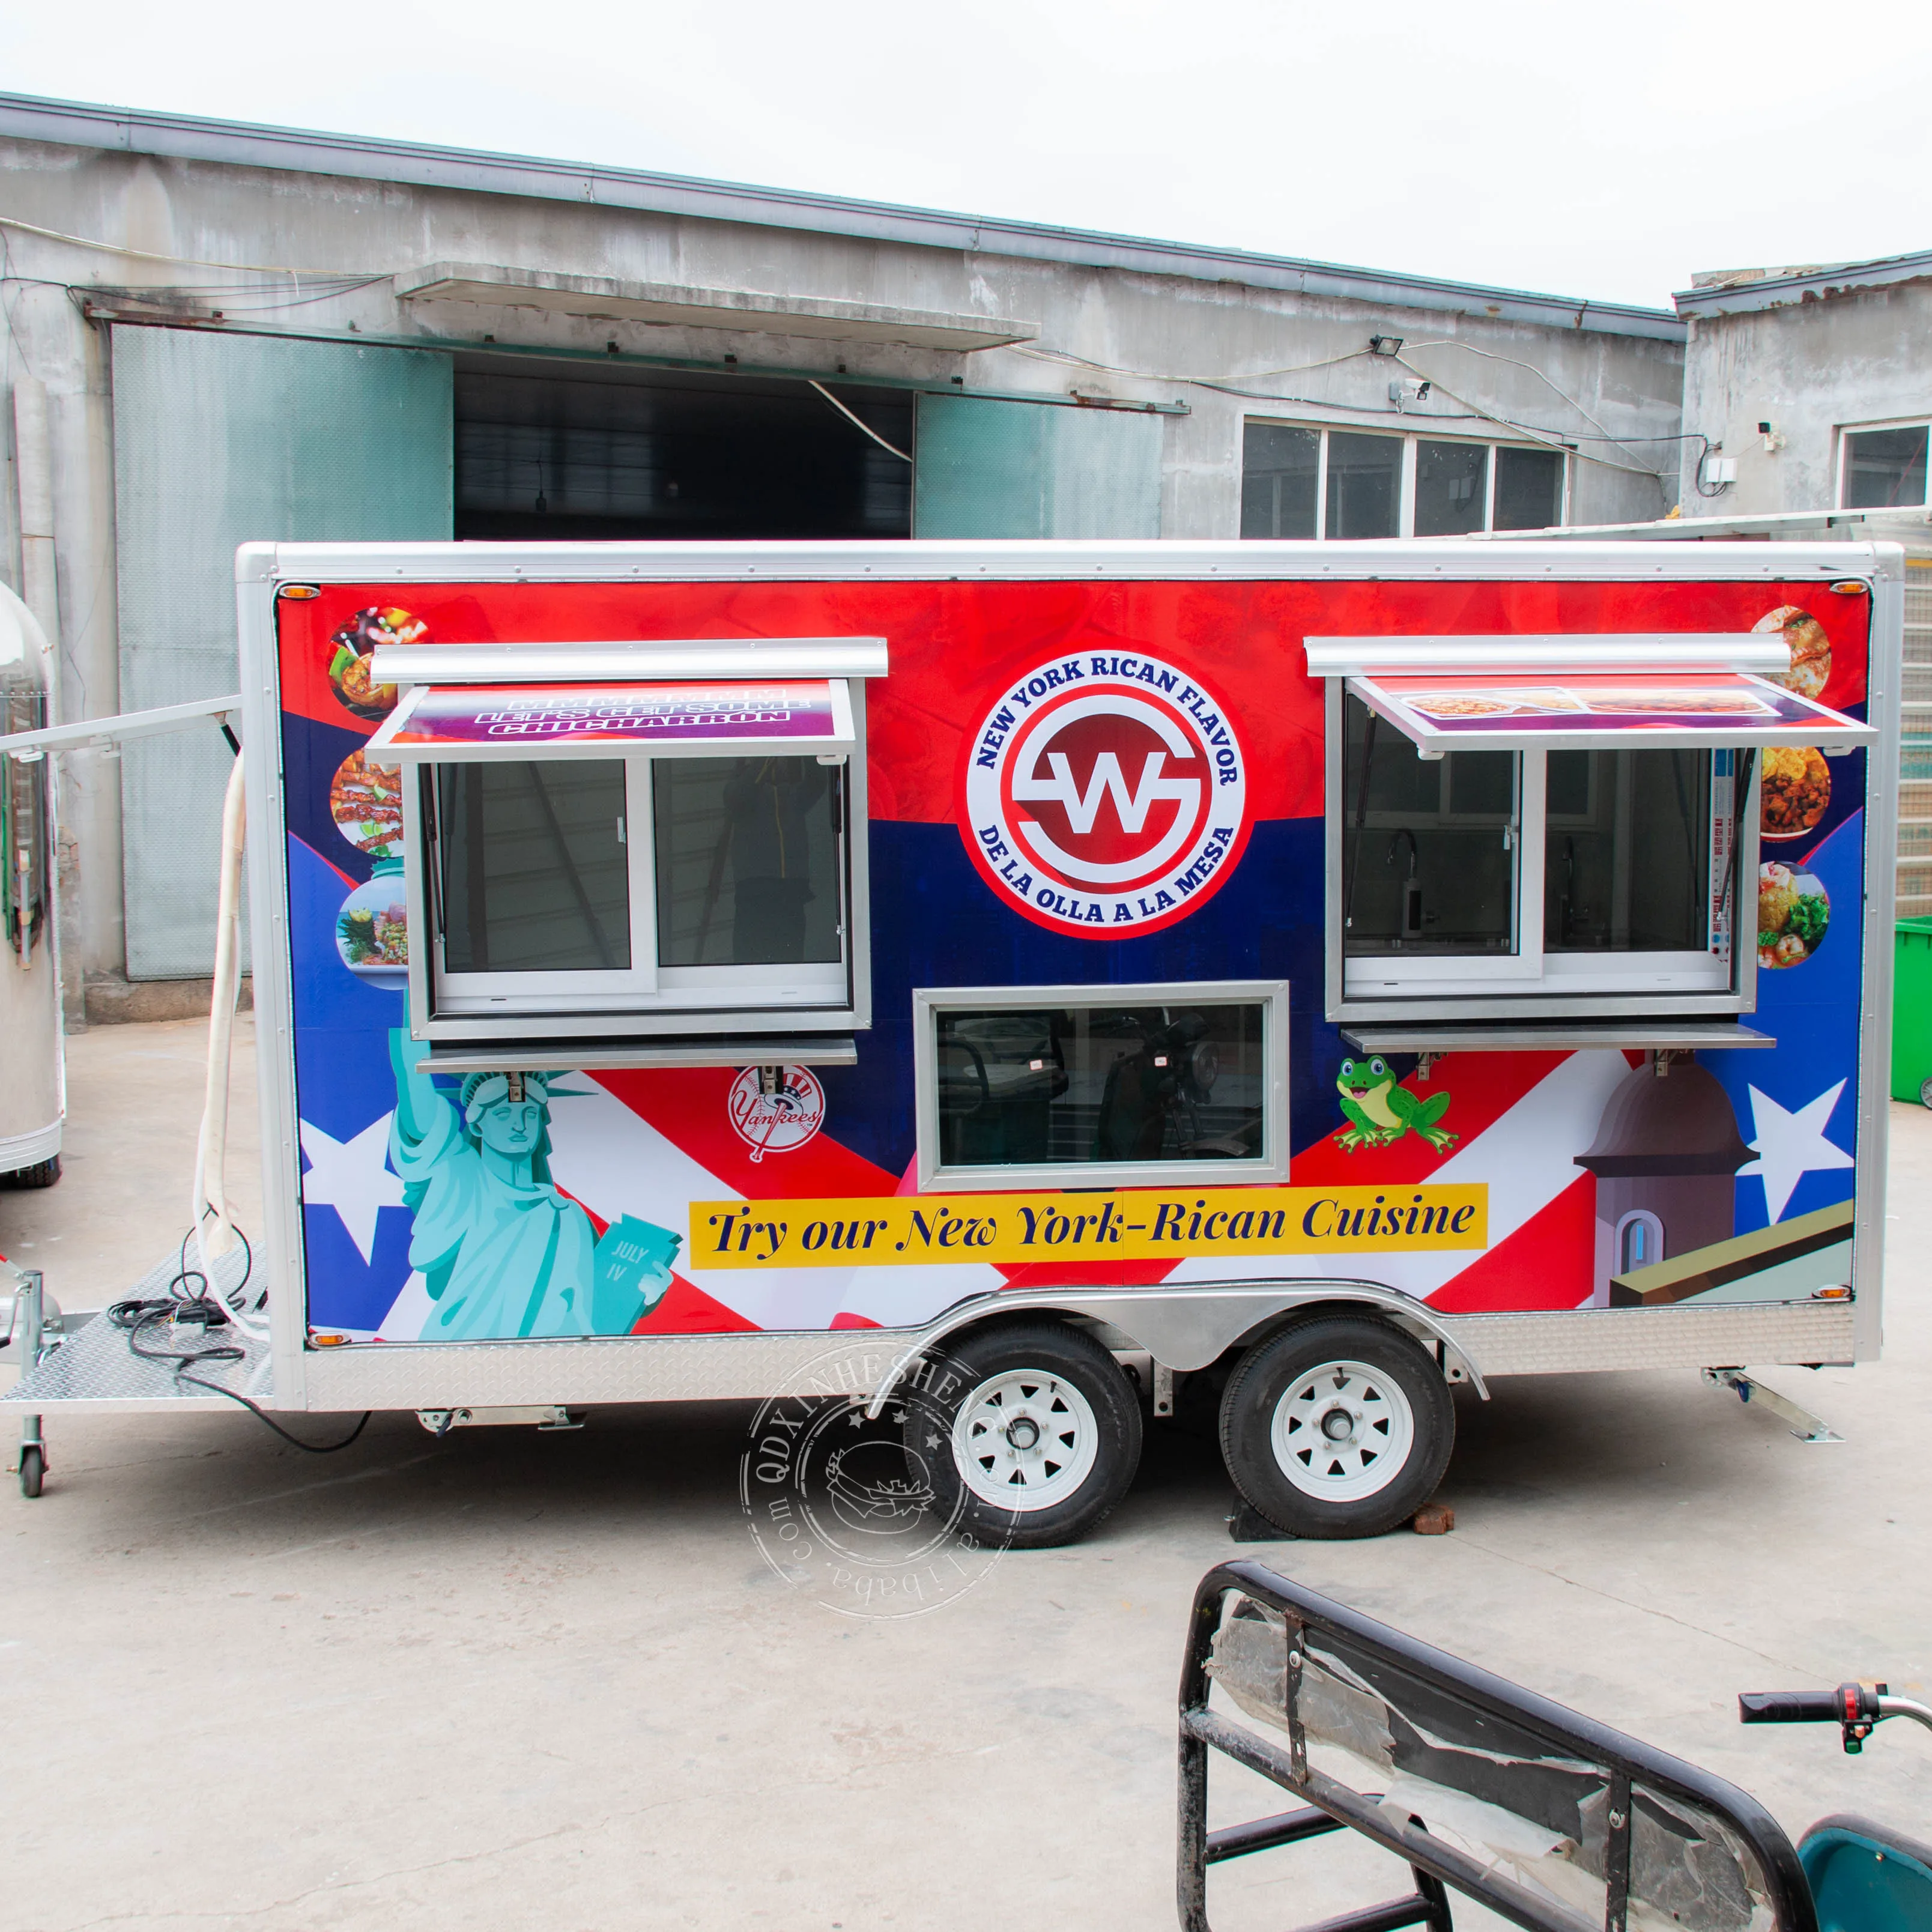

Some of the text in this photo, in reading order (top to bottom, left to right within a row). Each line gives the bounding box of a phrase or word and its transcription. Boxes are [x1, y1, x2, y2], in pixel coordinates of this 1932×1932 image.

[474, 699, 812, 724] LET'S GET SOME
[488, 710, 791, 735] CHICHARRÓN
[976, 657, 1238, 786] NEW YORK RICAN FLAVOR
[978, 825, 1234, 923] DE LA OLLA A LA MESA
[731, 1089, 822, 1130] Yankees
[709, 1206, 787, 1261] Try
[802, 1220, 888, 1250] our
[895, 1207, 998, 1252] New
[1302, 1195, 1476, 1238] Cuisine
[611, 1240, 650, 1264] JULY
[606, 1263, 628, 1282] IV
